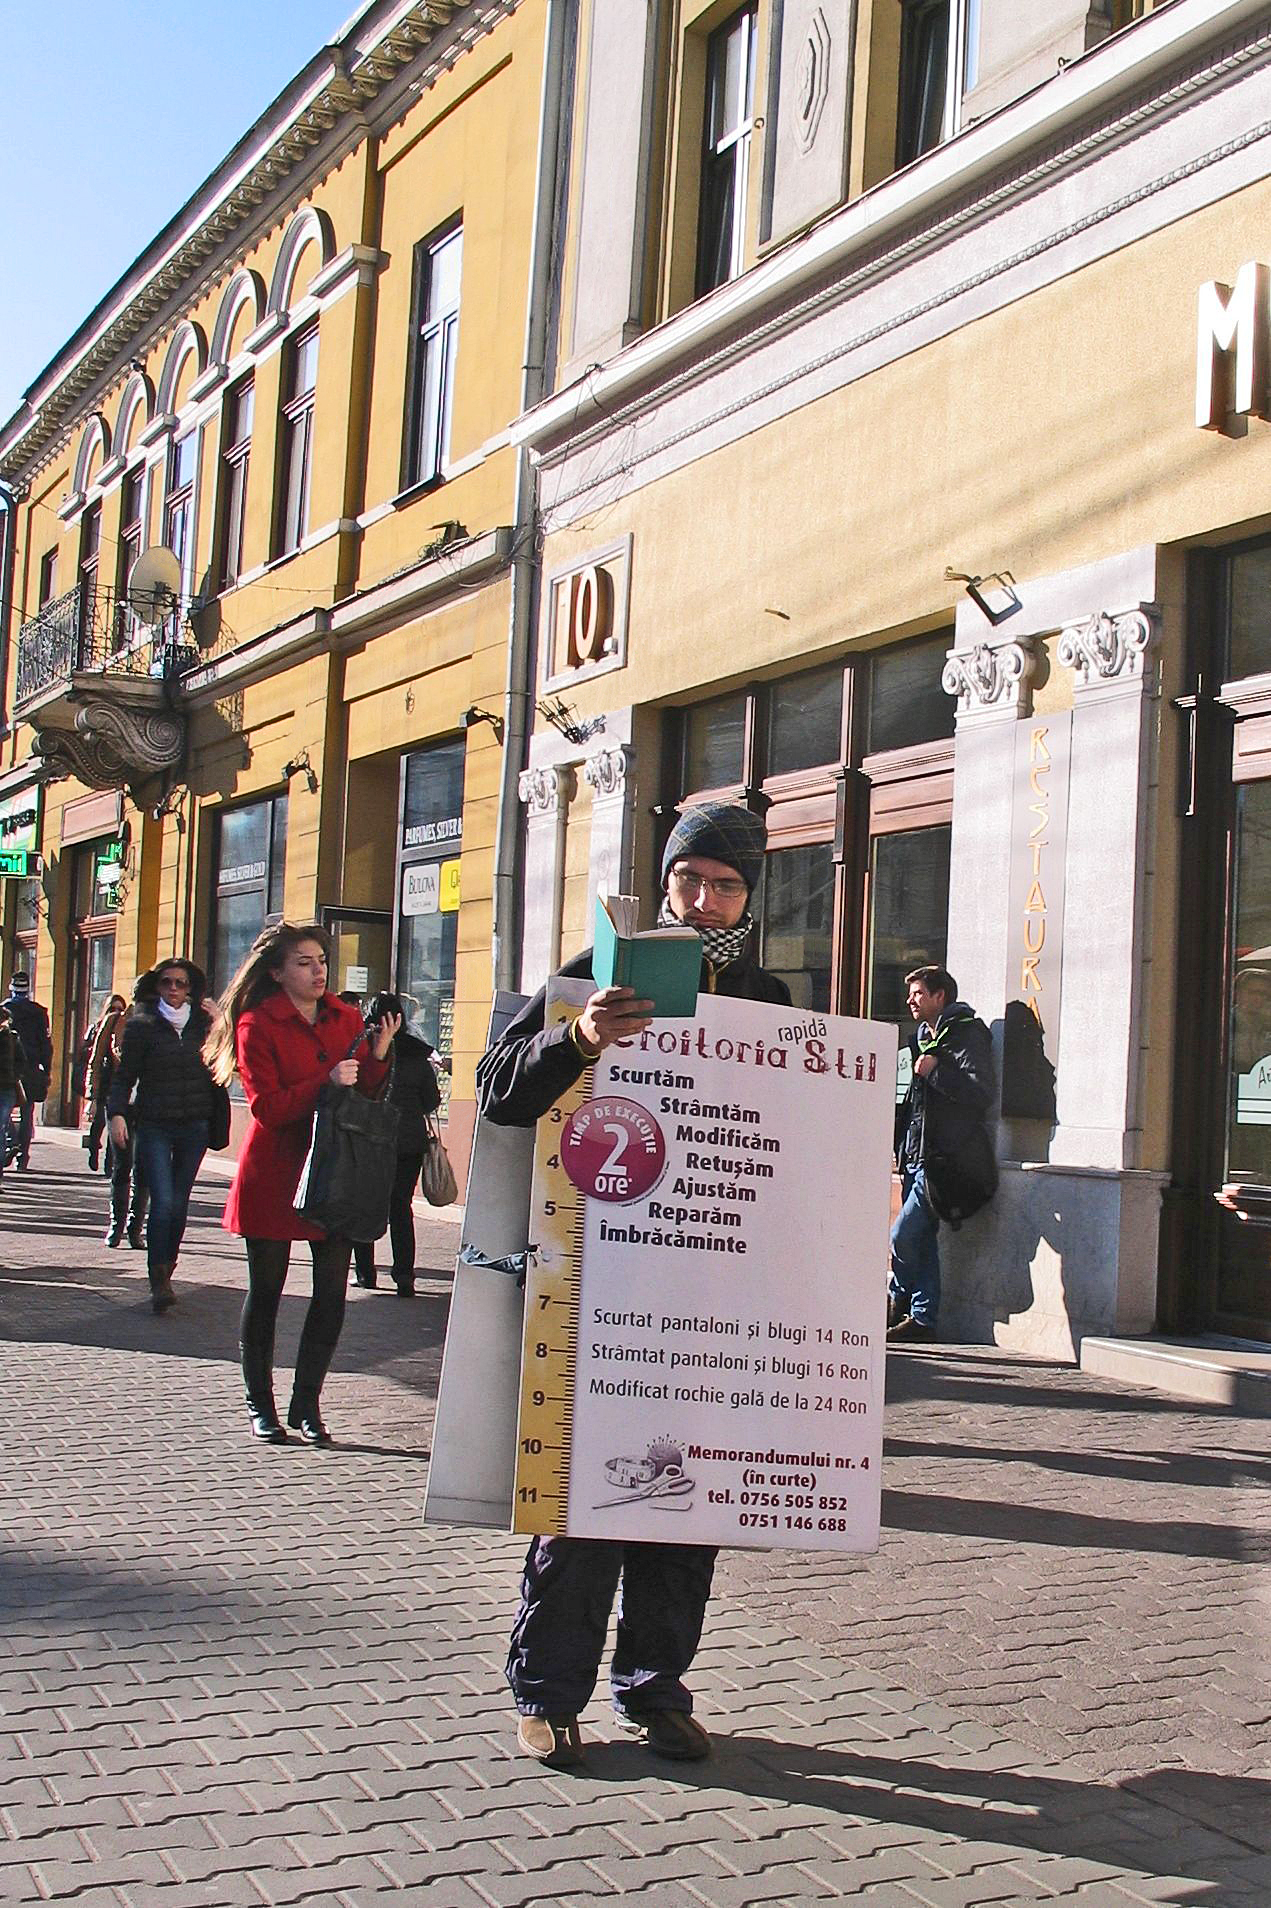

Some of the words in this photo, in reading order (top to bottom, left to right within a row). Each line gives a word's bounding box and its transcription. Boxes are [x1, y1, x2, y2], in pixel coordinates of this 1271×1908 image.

[778, 1018, 828, 1045] rapidă
[803, 1039, 877, 1083] Stil
[609, 1065, 695, 1090] Scurtăm
[550, 1108, 562, 1123] 3
[660, 1097, 761, 1124] Strâmtăm
[569, 1114, 592, 1147] TIMP
[594, 1104, 612, 1119] DE
[598, 1122, 630, 1177] 2
[676, 1125, 781, 1153] Modificăm
[546, 1154, 560, 1170] 4
[686, 1152, 774, 1179] Retușăm
[672, 1177, 757, 1202] Ajustăm
[544, 1200, 557, 1216] 5
[648, 1201, 742, 1227] Reparăm
[599, 1219, 747, 1254] Îmbrăcăminte
[538, 1294, 551, 1311] 7
[593, 1308, 653, 1328] Scurtat
[661, 1316, 740, 1336] pantaloni
[747, 1320, 760, 1341] și
[768, 1321, 807, 1345] blugi
[815, 1328, 833, 1344] 14
[841, 1330, 869, 1347] Ron
[535, 1342, 548, 1358] 8
[591, 1343, 665, 1364] Strâmtat
[670, 1352, 749, 1371] pantaloni
[754, 1356, 767, 1376] și
[771, 1356, 811, 1380] blugi
[817, 1362, 835, 1378] 16
[840, 1363, 868, 1380] Ron
[532, 1390, 545, 1406] 9
[589, 1378, 669, 1400] Modificat
[674, 1384, 725, 1404] rochie
[730, 1389, 765, 1409] gală
[770, 1391, 790, 1409] de
[795, 1392, 809, 1410] la
[814, 1395, 833, 1411] 24
[839, 1398, 867, 1414] Ron
[521, 1438, 542, 1455] 10
[687, 1445, 831, 1468] Memorandumului
[835, 1457, 856, 1469] nr.
[860, 1456, 870, 1470] 4
[742, 1468, 765, 1487] (în
[769, 1472, 817, 1491] curte)
[518, 1487, 538, 1503] 11
[707, 1489, 736, 1504] tel.
[740, 1491, 780, 1507] 0756
[784, 1494, 814, 1509] 505
[818, 1496, 848, 1511] 852
[739, 1513, 779, 1528] 0751
[785, 1515, 813, 1530] 146
[817, 1517, 847, 1532] 688
